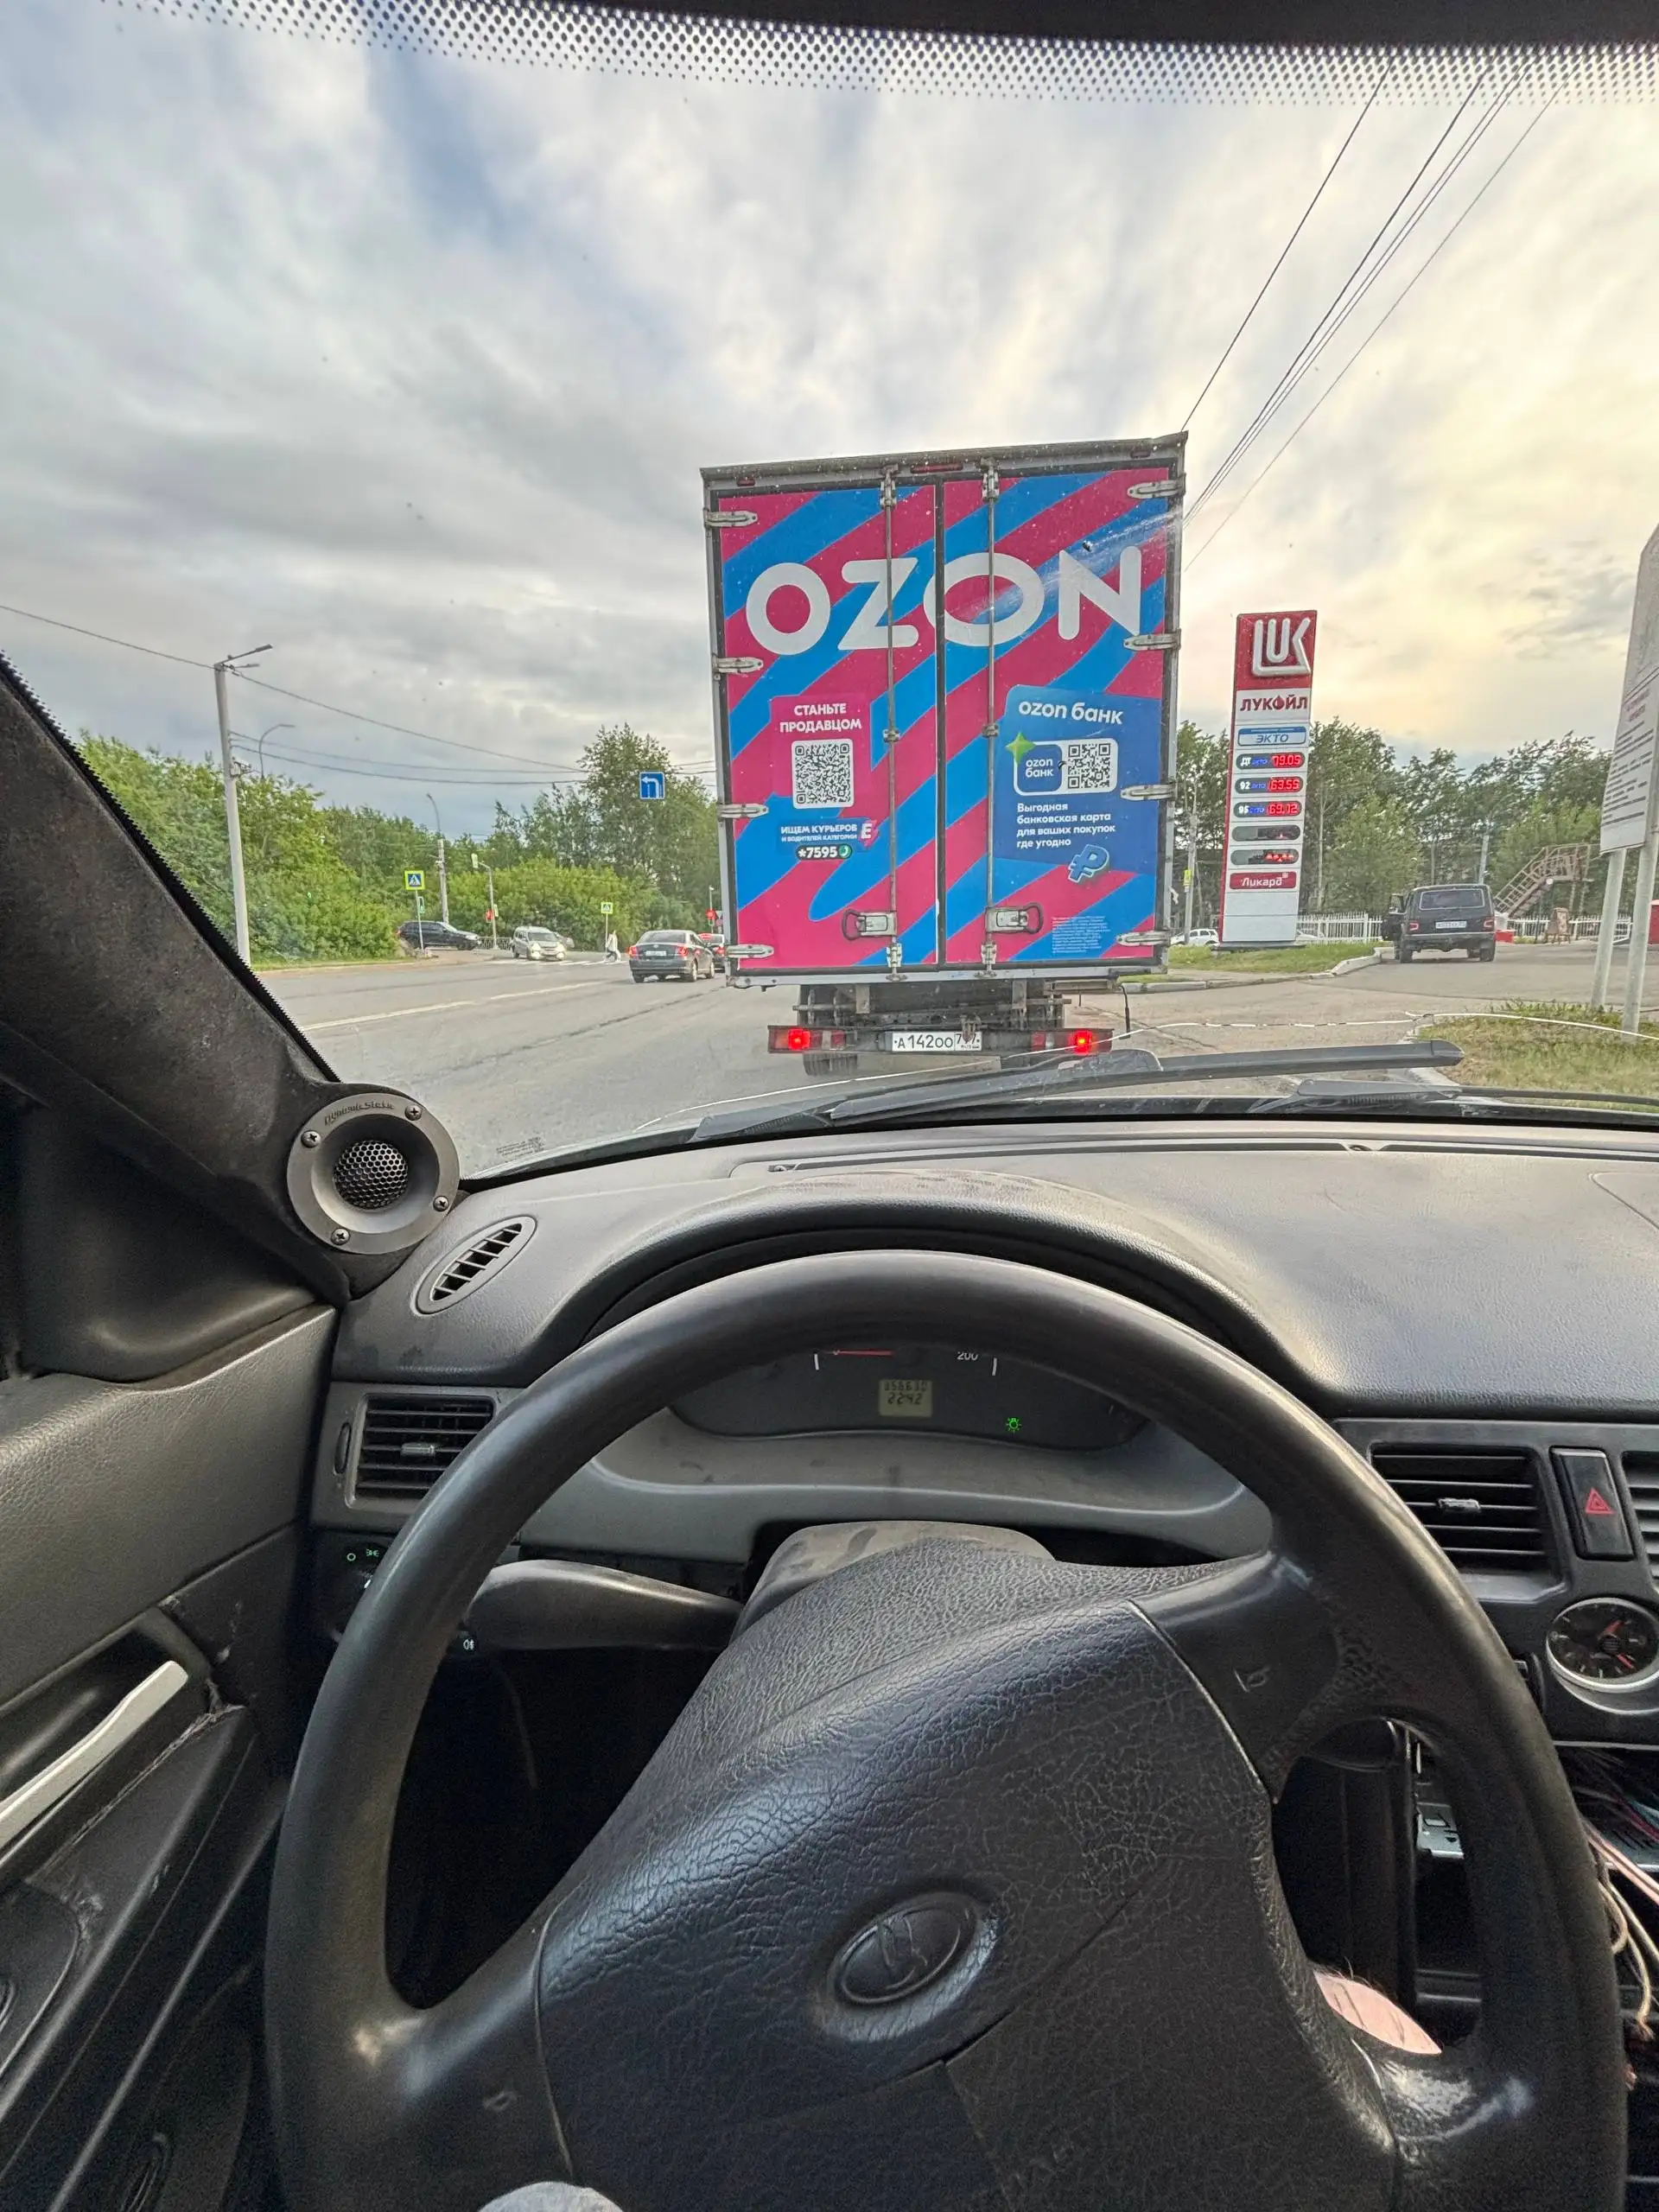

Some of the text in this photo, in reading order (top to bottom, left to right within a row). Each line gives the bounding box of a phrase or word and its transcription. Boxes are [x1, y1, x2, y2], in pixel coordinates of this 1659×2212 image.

[746, 545, 1142, 655] OZON
[794, 702, 847, 716] СТАНЬТЕ
[1071, 702, 1123, 724] банк
[779, 719, 861, 734] ПРОДАВЦОМ
[1255, 734, 1289, 743] ЭКТО
[1026, 759, 1053, 767] ozon
[1025, 767, 1054, 778] банк
[1239, 781, 1250, 790] 92
[1017, 803, 1068, 813] Выгодная
[1238, 805, 1249, 814] 95
[1017, 813, 1111, 824] банковская карта
[780, 823, 857, 835] ИЩЕМ КУРЬЕРОВ
[1016, 826, 1116, 837] для ваших покупок
[1036, 838, 1071, 849] угодно
